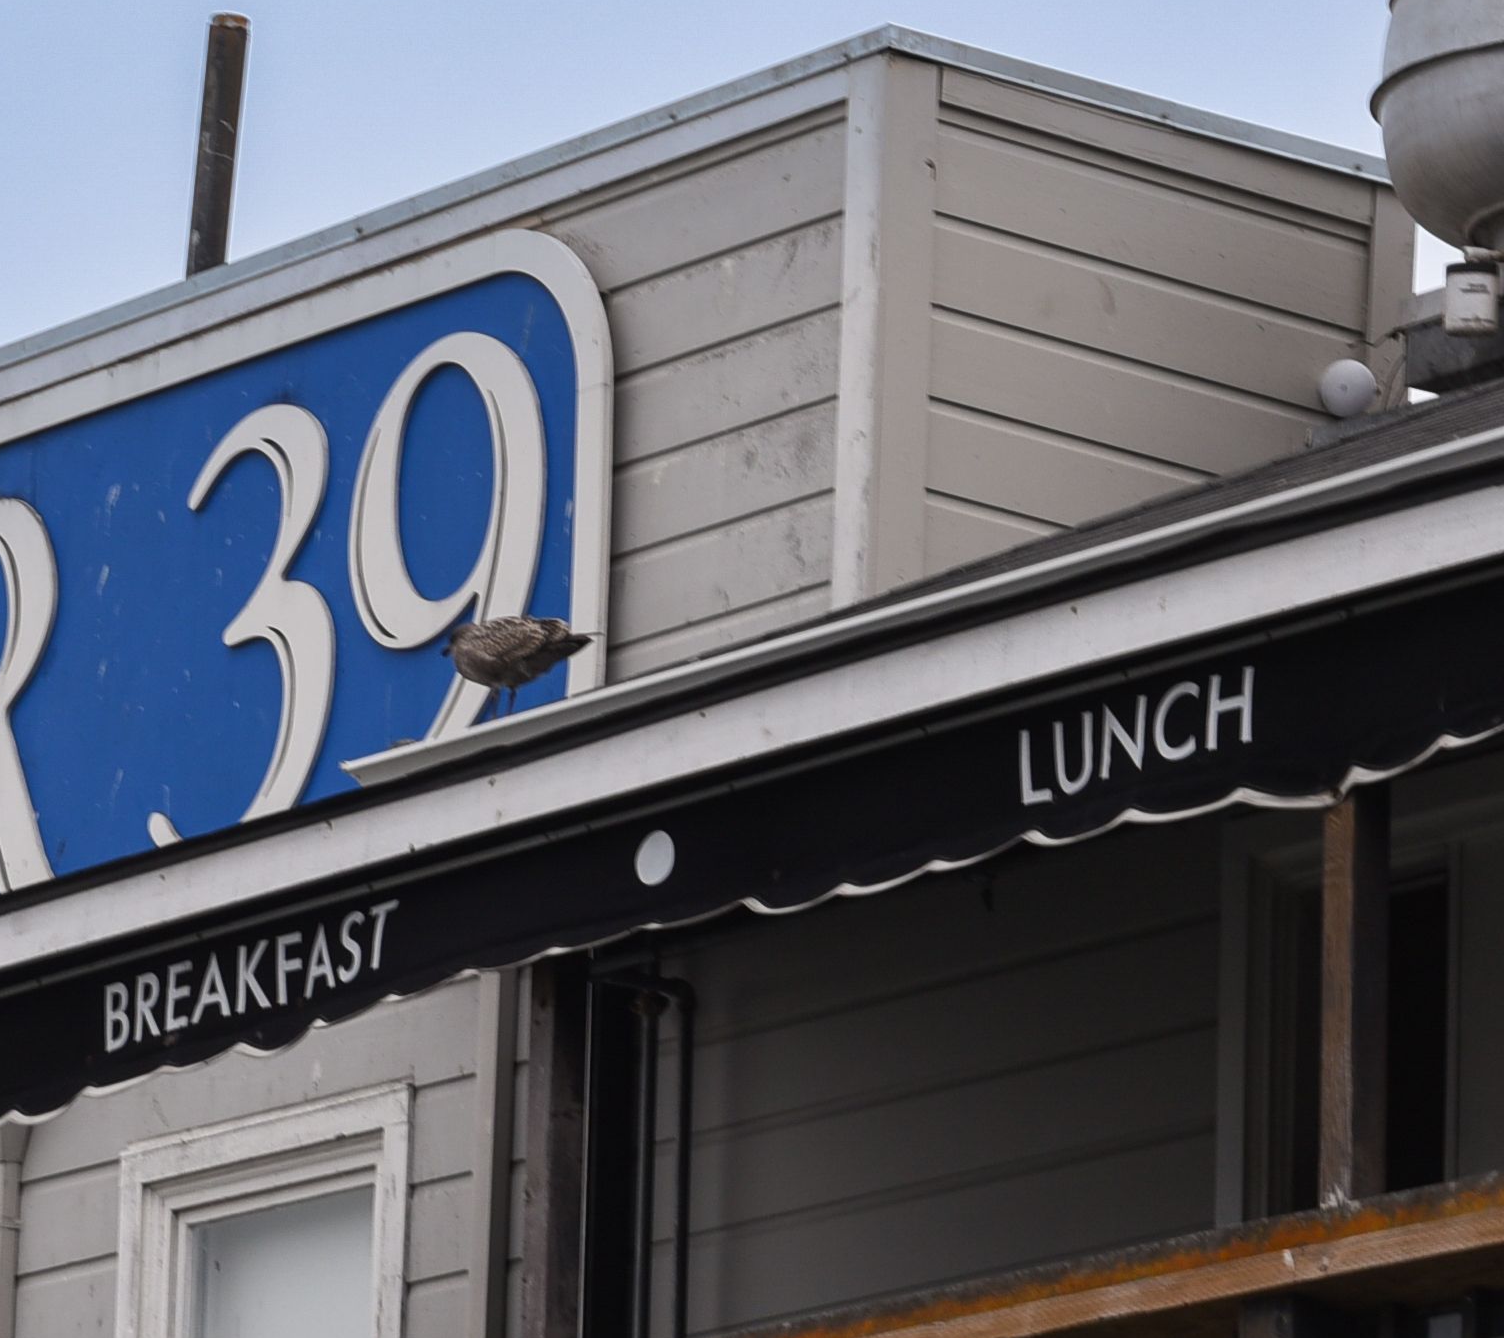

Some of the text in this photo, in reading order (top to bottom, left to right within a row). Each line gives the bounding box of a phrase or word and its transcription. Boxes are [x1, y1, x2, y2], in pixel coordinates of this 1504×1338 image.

[147, 331, 548, 849] 39
[104, 900, 399, 1053] BREAKFAST
[1018, 665, 1255, 806] LUNCH
